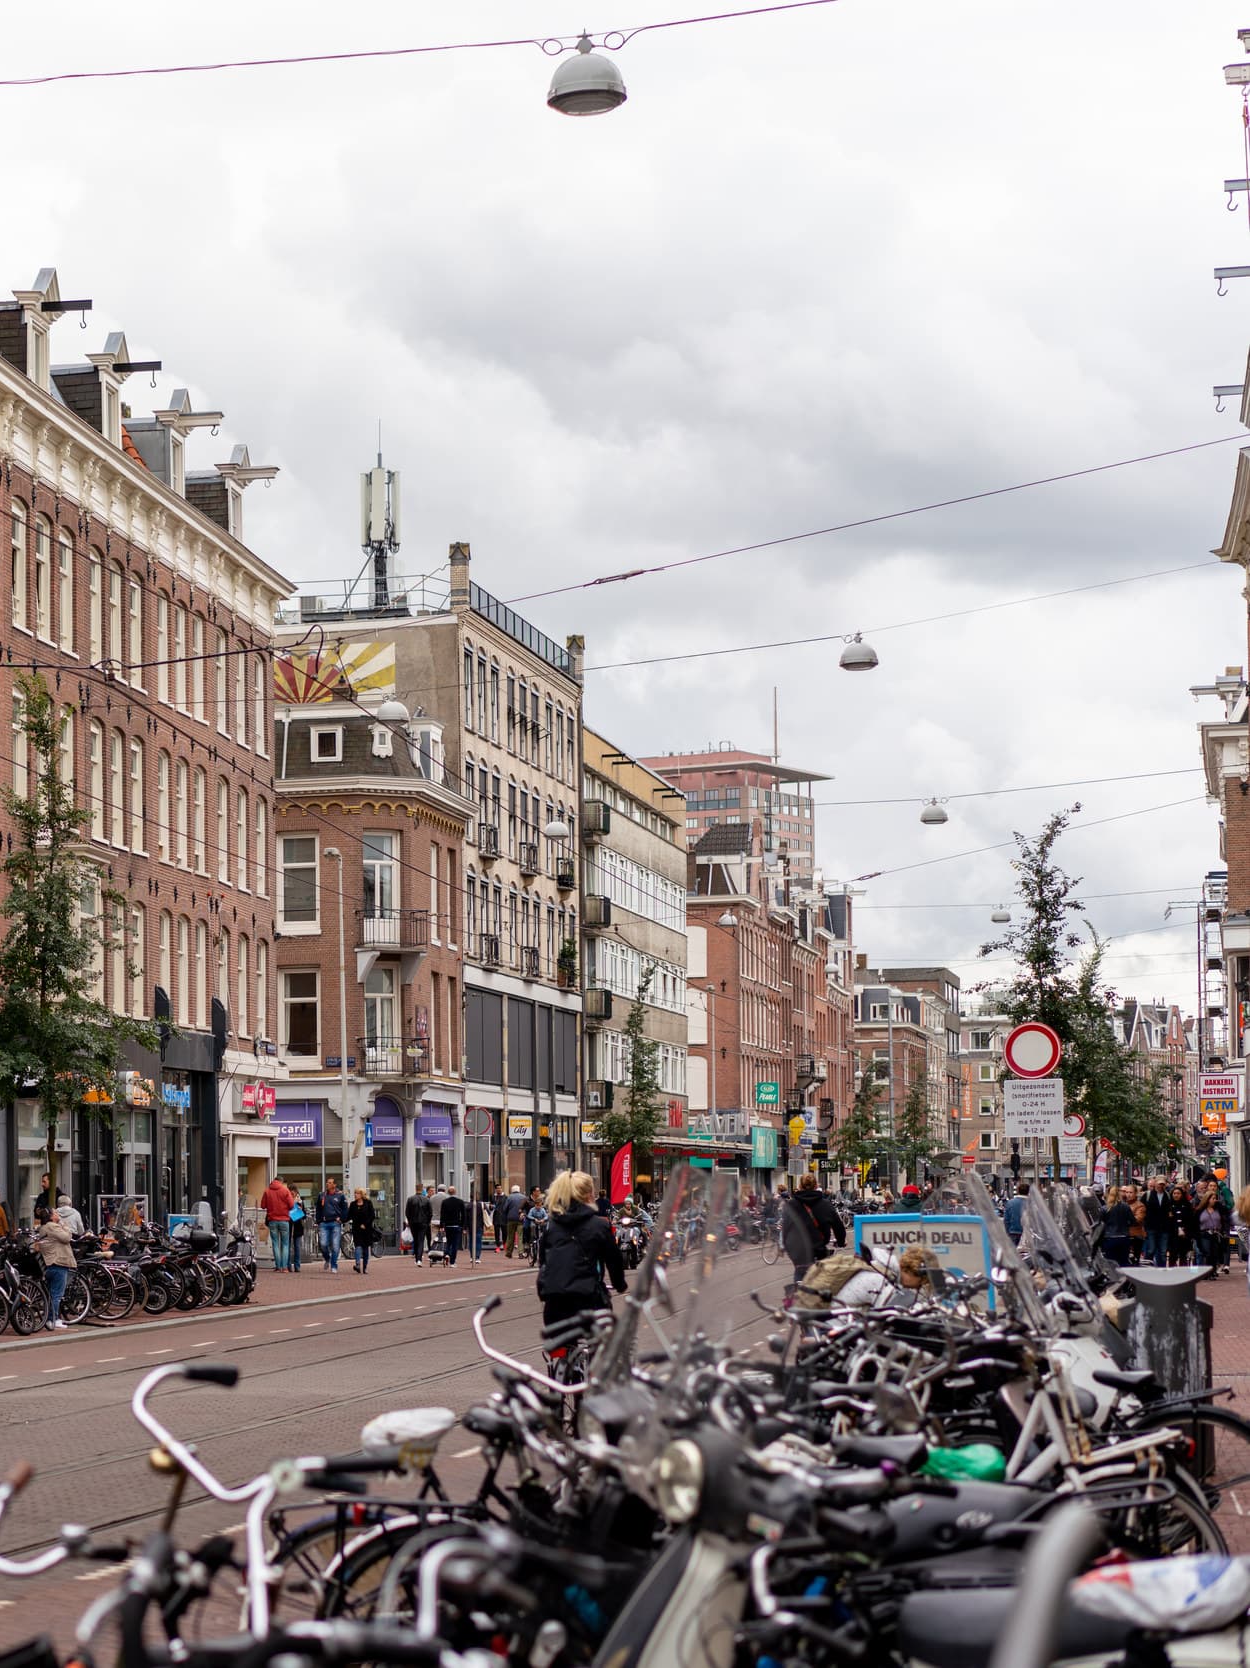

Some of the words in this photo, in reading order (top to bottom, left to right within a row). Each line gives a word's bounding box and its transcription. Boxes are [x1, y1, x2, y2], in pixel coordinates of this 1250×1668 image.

[1202, 1087, 1236, 1095] RISTRETTO
[1205, 1101, 1234, 1111] ATM
[872, 1230, 927, 1245] LUNCH
[931, 1231, 973, 1244] DEAL!
